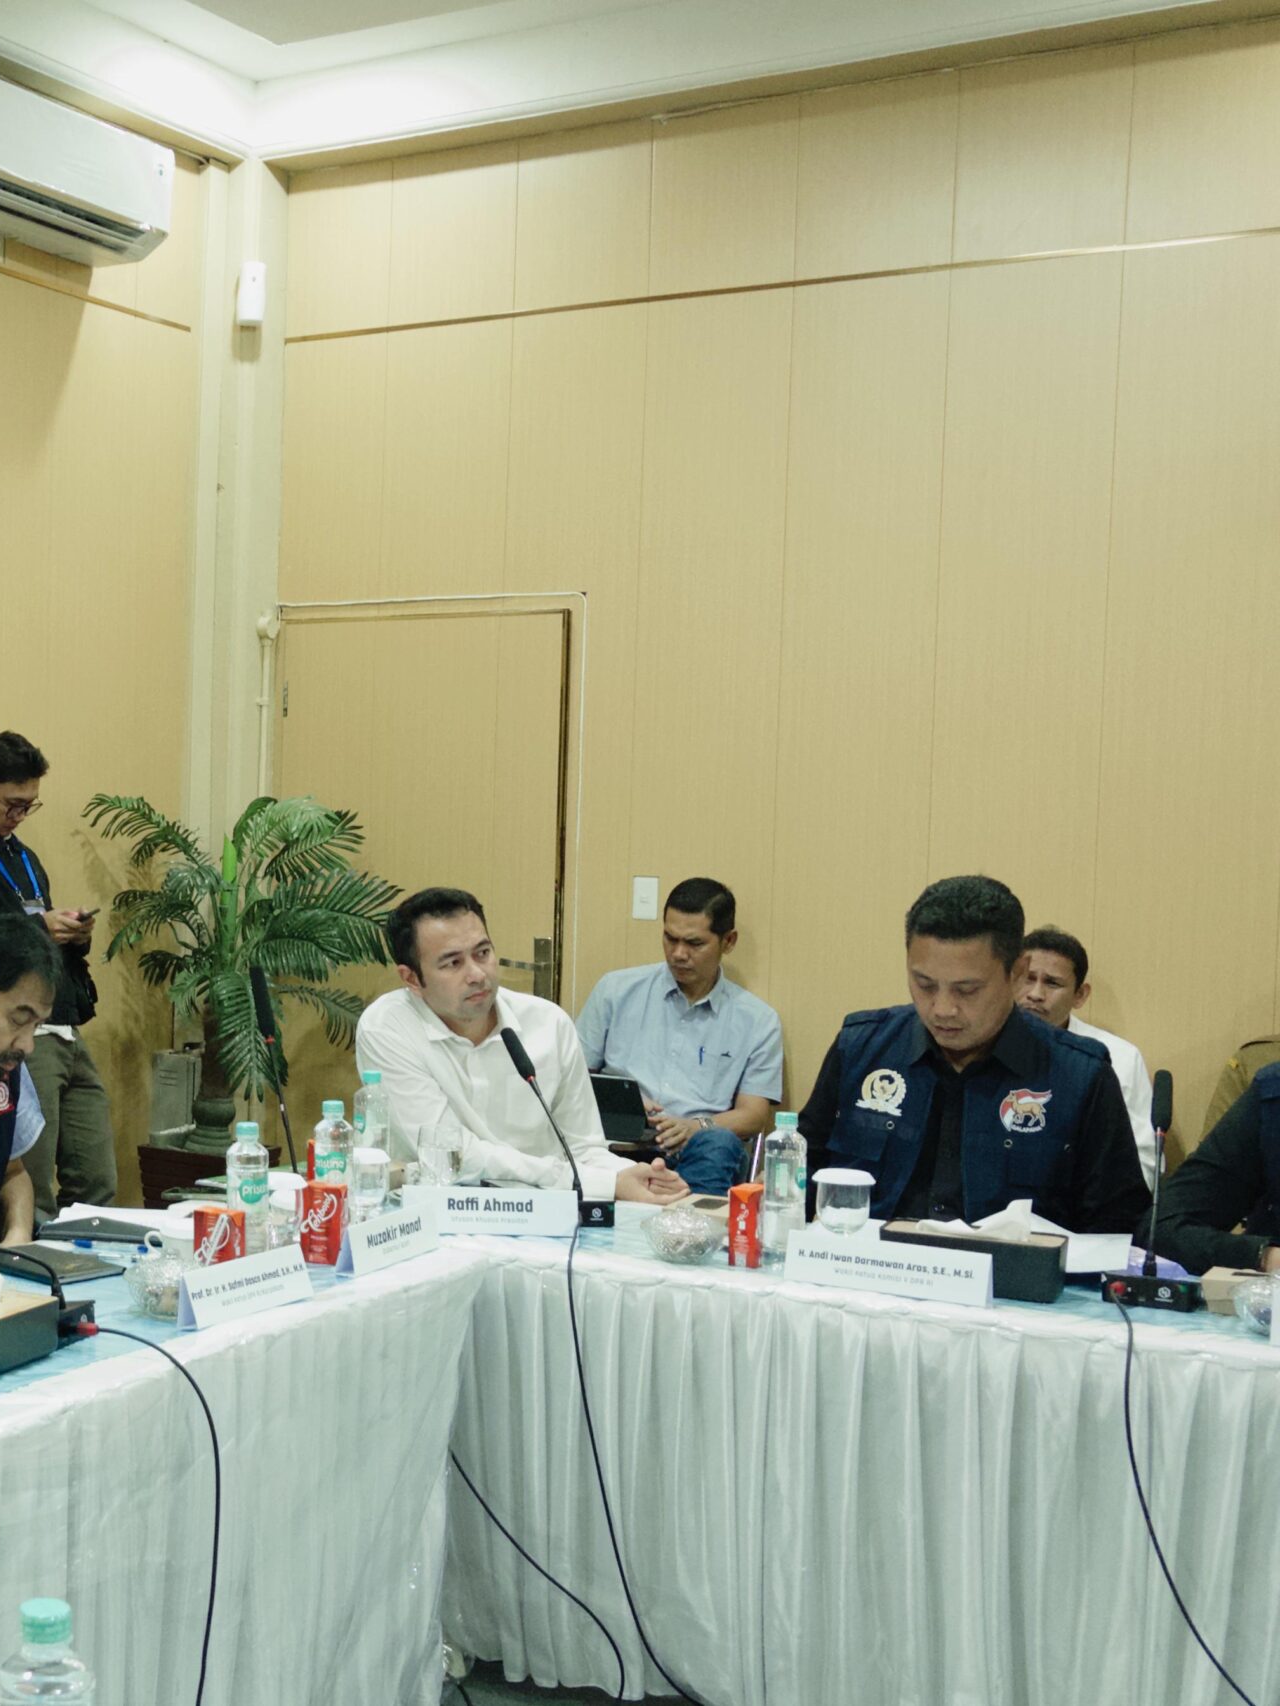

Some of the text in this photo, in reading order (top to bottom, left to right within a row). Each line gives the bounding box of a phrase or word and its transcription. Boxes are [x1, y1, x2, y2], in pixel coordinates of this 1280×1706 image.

[448, 1197, 533, 1213] Raffi Ahmad
[367, 1225, 397, 1248] Muzakir
[809, 1250, 829, 1260] Andi
[830, 1252, 853, 1263] Iwan
[854, 1256, 904, 1270] Darmawan
